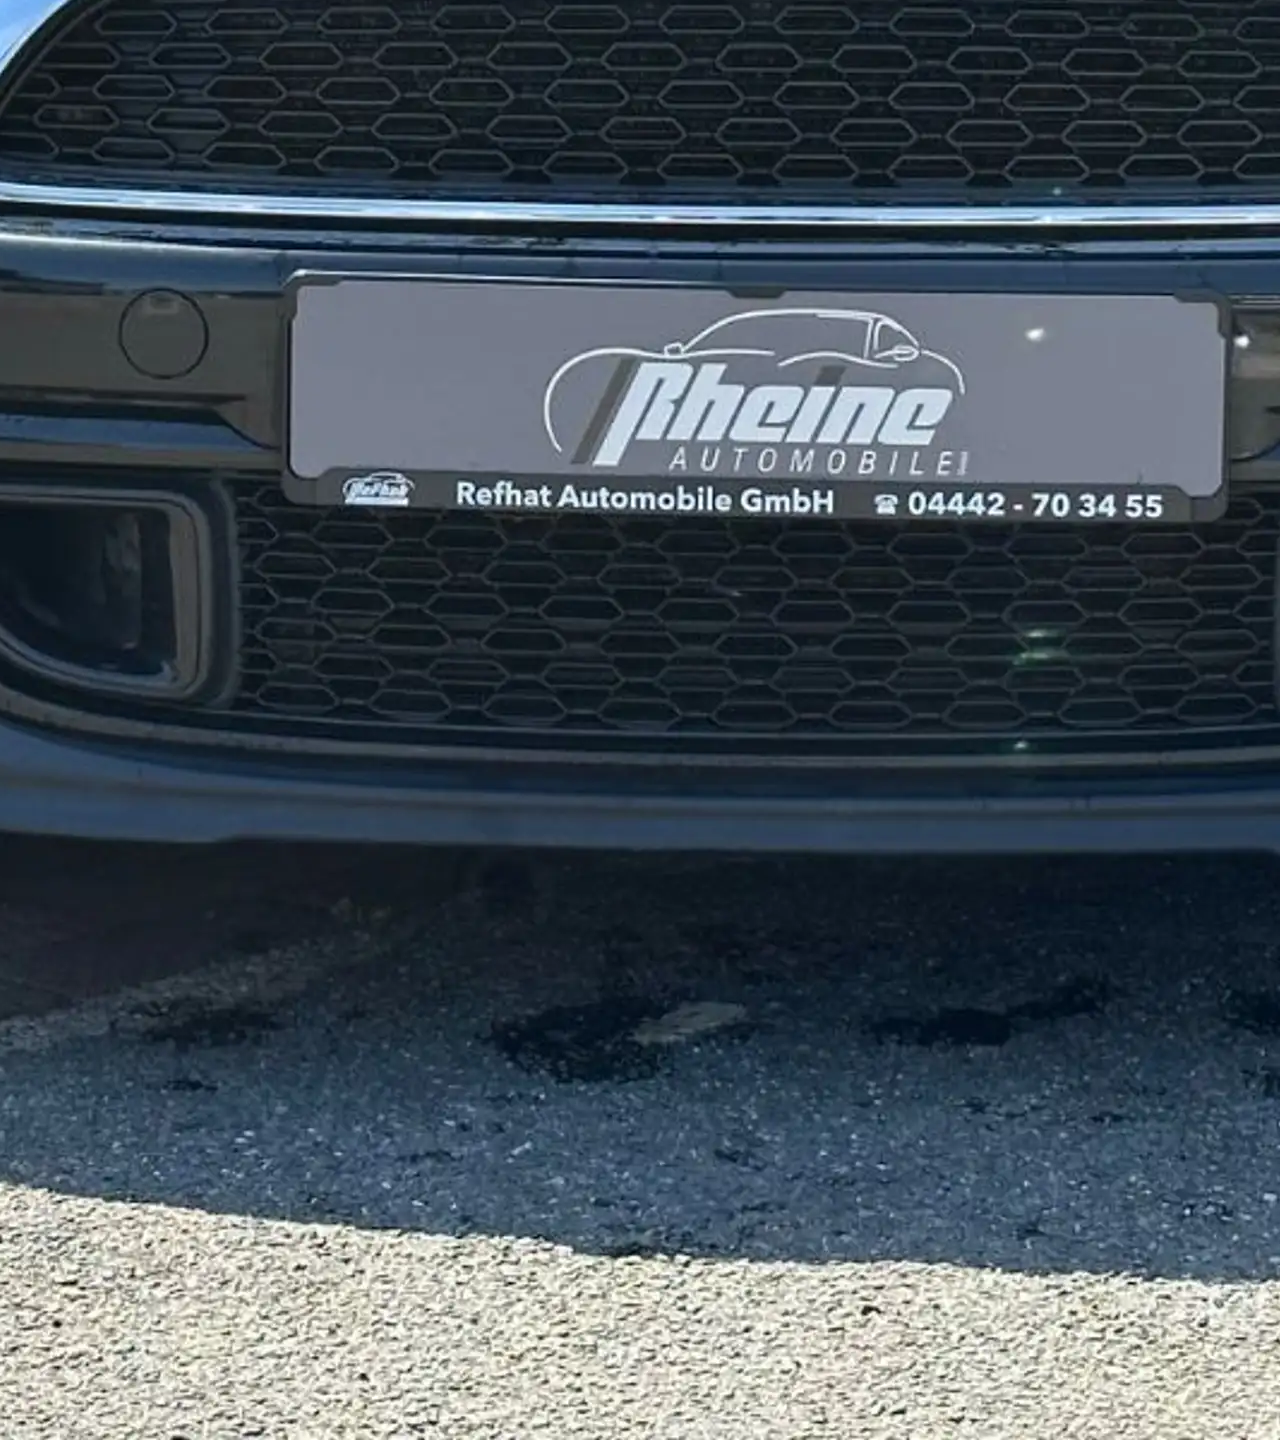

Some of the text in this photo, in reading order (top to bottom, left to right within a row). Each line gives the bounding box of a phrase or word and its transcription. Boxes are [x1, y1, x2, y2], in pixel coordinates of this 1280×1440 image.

[592, 362, 953, 467] Rheine
[456, 480, 552, 508] Refhat
[557, 483, 732, 512] Automobile
[740, 487, 834, 513] GmbH
[907, 491, 1006, 516] 04442
[1031, 492, 1070, 517] 70
[1078, 493, 1117, 517] 34
[1125, 493, 1164, 518] 55
